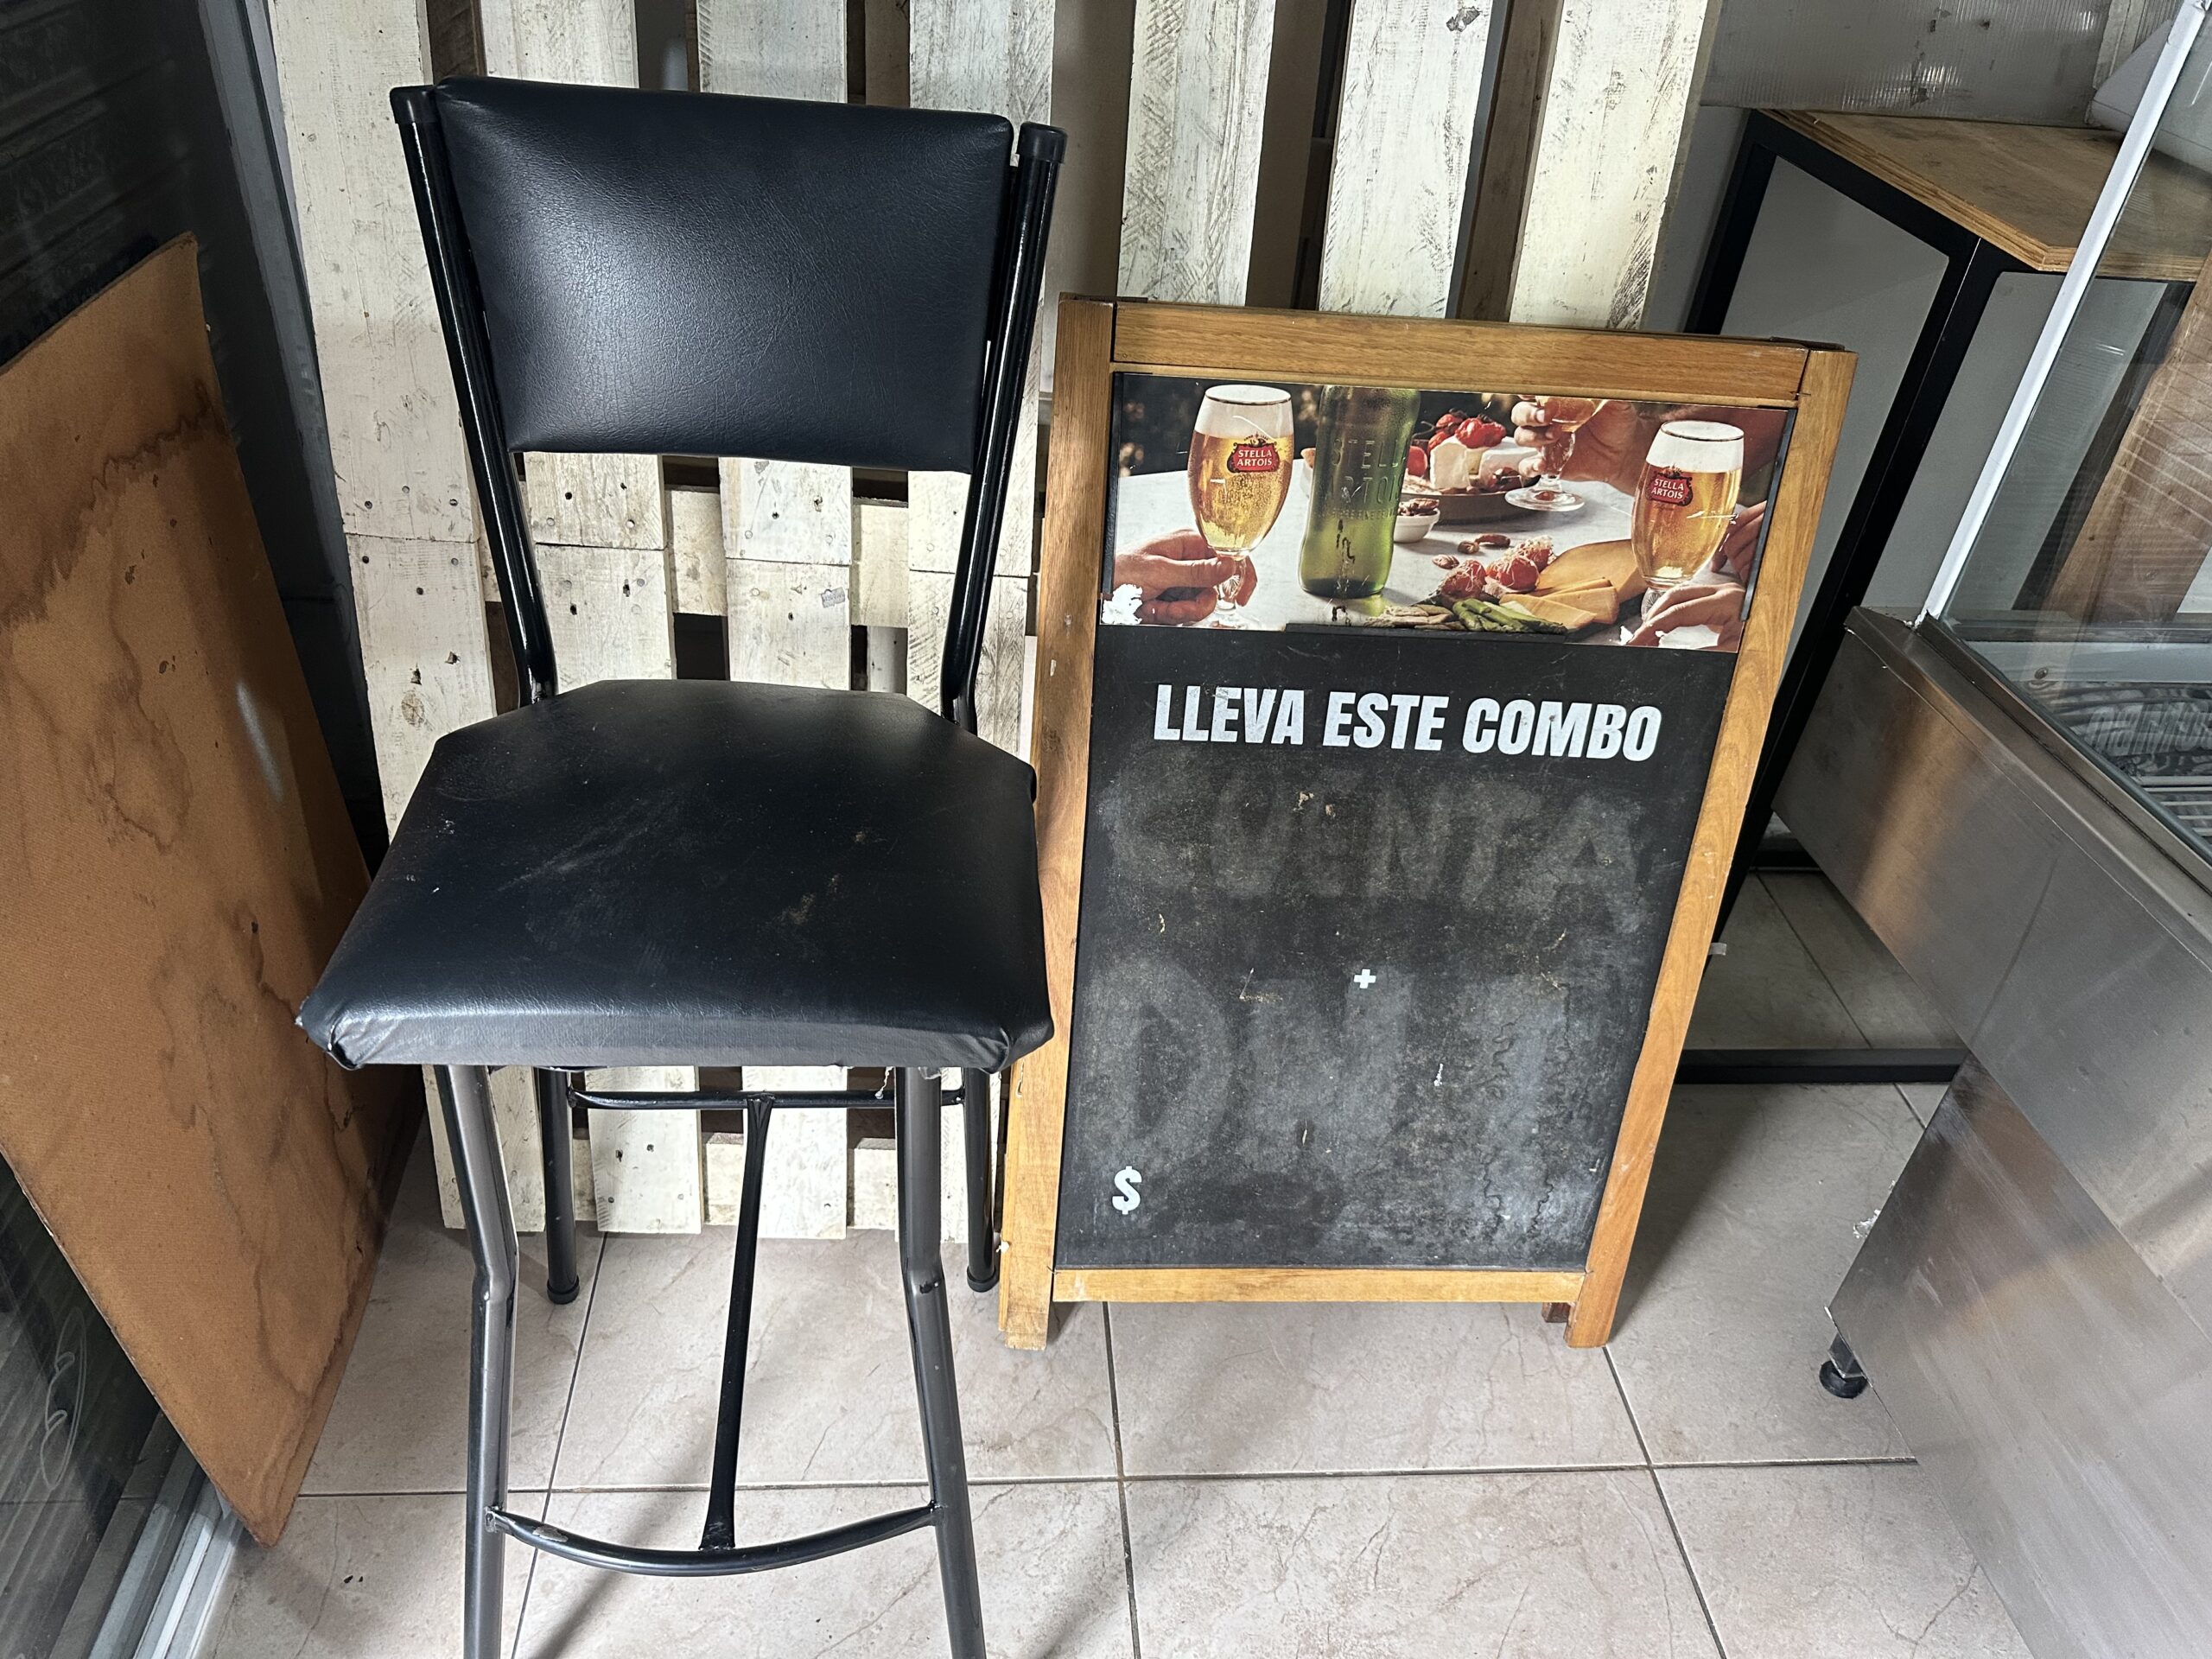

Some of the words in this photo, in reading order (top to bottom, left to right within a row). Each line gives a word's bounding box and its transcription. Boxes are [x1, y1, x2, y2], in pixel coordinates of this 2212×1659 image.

[1238, 449, 1272, 458] STELLA
[1332, 438, 1402, 469] STELL
[1236, 458, 1272, 467] ARTOIS
[1654, 478, 1684, 491] STELLA
[1650, 486, 1683, 499] ARTOIS
[1154, 684, 1305, 746] LLEVA
[1322, 691, 1450, 751] ESTE
[1462, 697, 1662, 762] COMBO
[1111, 1165, 1142, 1216] $
